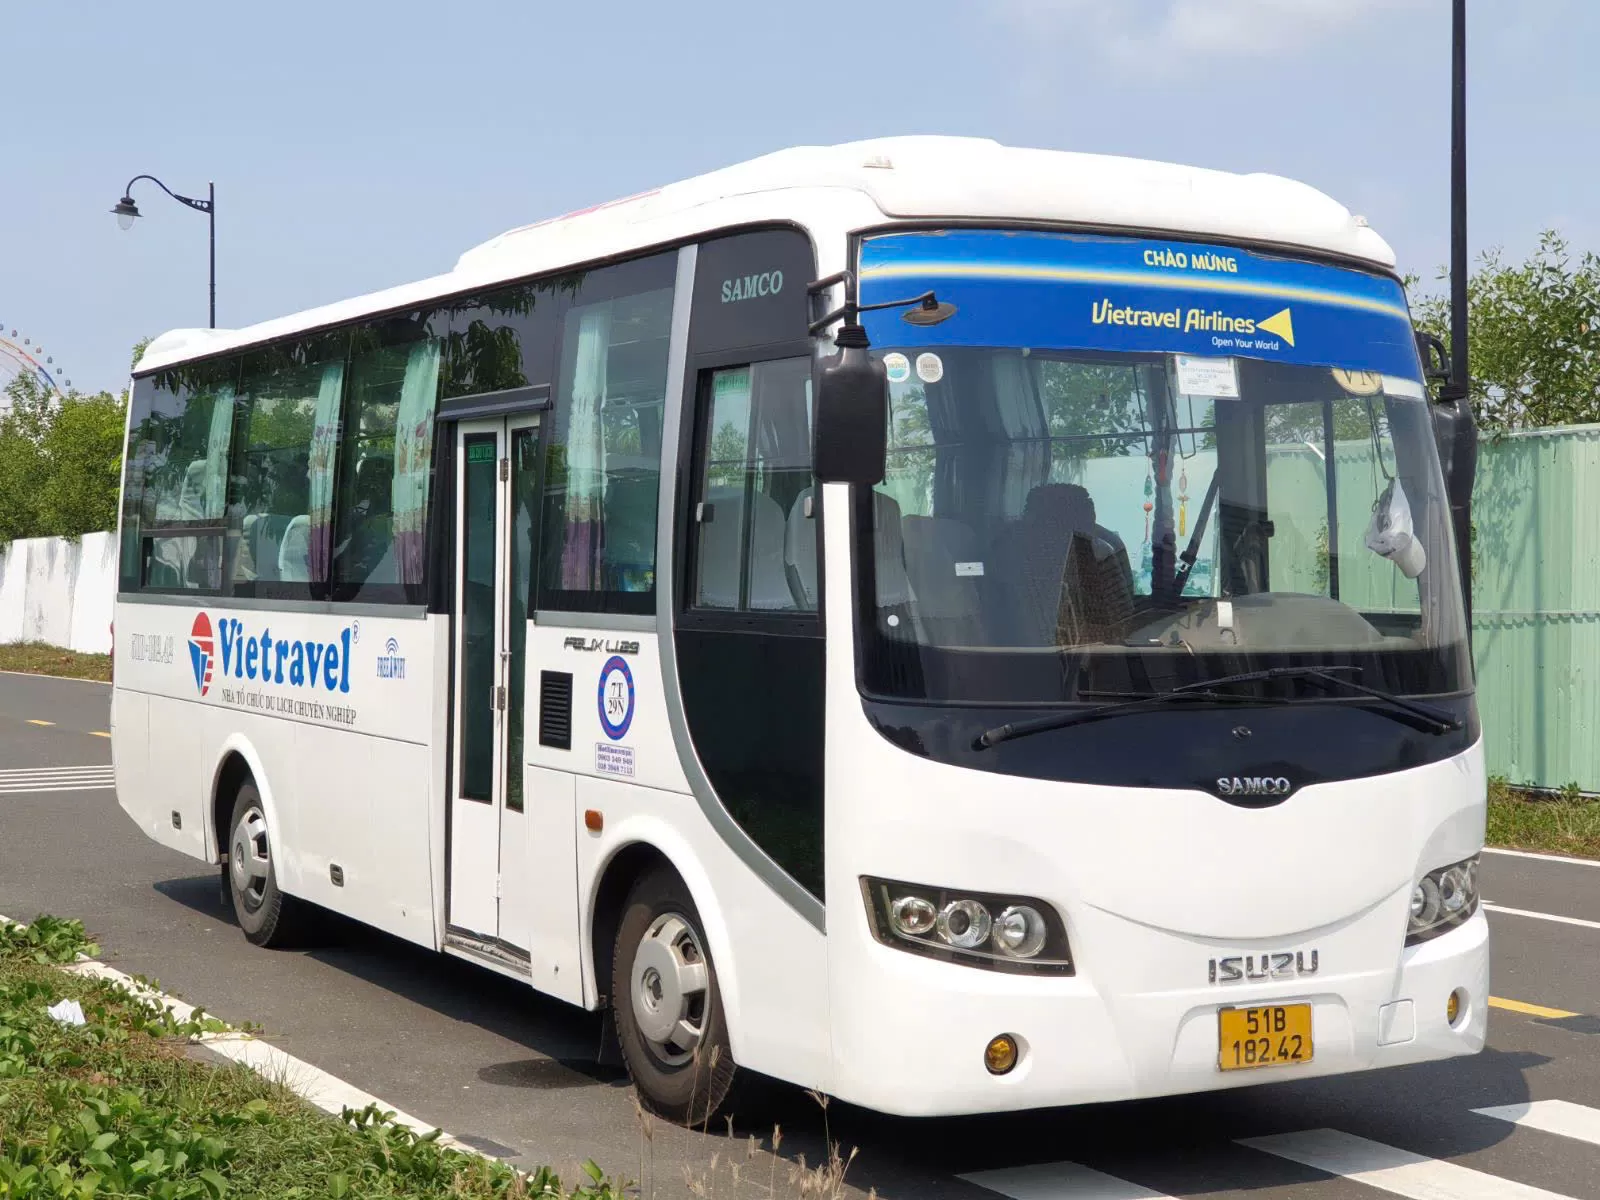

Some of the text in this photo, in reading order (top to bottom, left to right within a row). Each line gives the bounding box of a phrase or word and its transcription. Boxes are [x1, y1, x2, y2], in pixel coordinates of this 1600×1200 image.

[1144, 248, 1238, 274] CHÀO MỪNG
[722, 271, 784, 303] SAMCO
[1092, 298, 1256, 334] Vietravel Airlines
[1211, 336, 1280, 351] Open Your World
[218, 618, 350, 694] Vietravel
[377, 656, 389, 678] FREE
[611, 682, 624, 698] 7T
[222, 688, 235, 703] NHÀ
[246, 689, 265, 709] CHỨC
[265, 698, 276, 711] DU
[276, 699, 294, 714] LỊCH
[294, 699, 325, 721] CHUYÊN
[325, 704, 357, 726] NGHIỆP
[608, 699, 625, 715] 29N
[1217, 776, 1291, 796] SAMCO
[1208, 949, 1318, 984] ISUZU
[1246, 1006, 1287, 1034] 51B
[1232, 1035, 1303, 1066] 182.42
